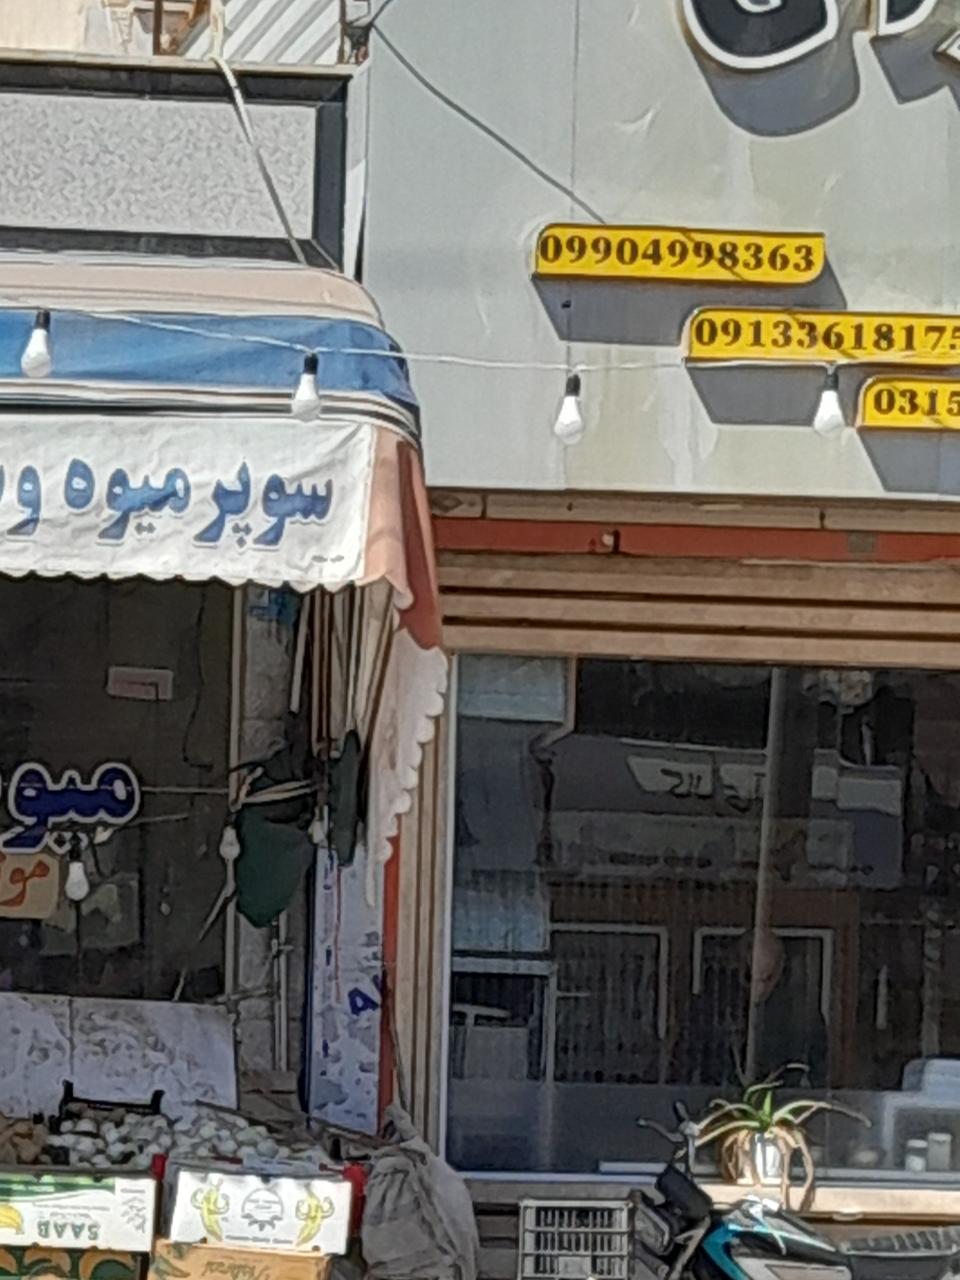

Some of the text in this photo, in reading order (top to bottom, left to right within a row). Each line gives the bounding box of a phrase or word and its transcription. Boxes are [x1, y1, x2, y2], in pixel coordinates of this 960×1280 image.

[540, 235, 815, 274] 09904998363
[63, 457, 191, 540] میوه
[192, 460, 334, 549] سوپر
[37, 1220, 102, 1241] SAAB
